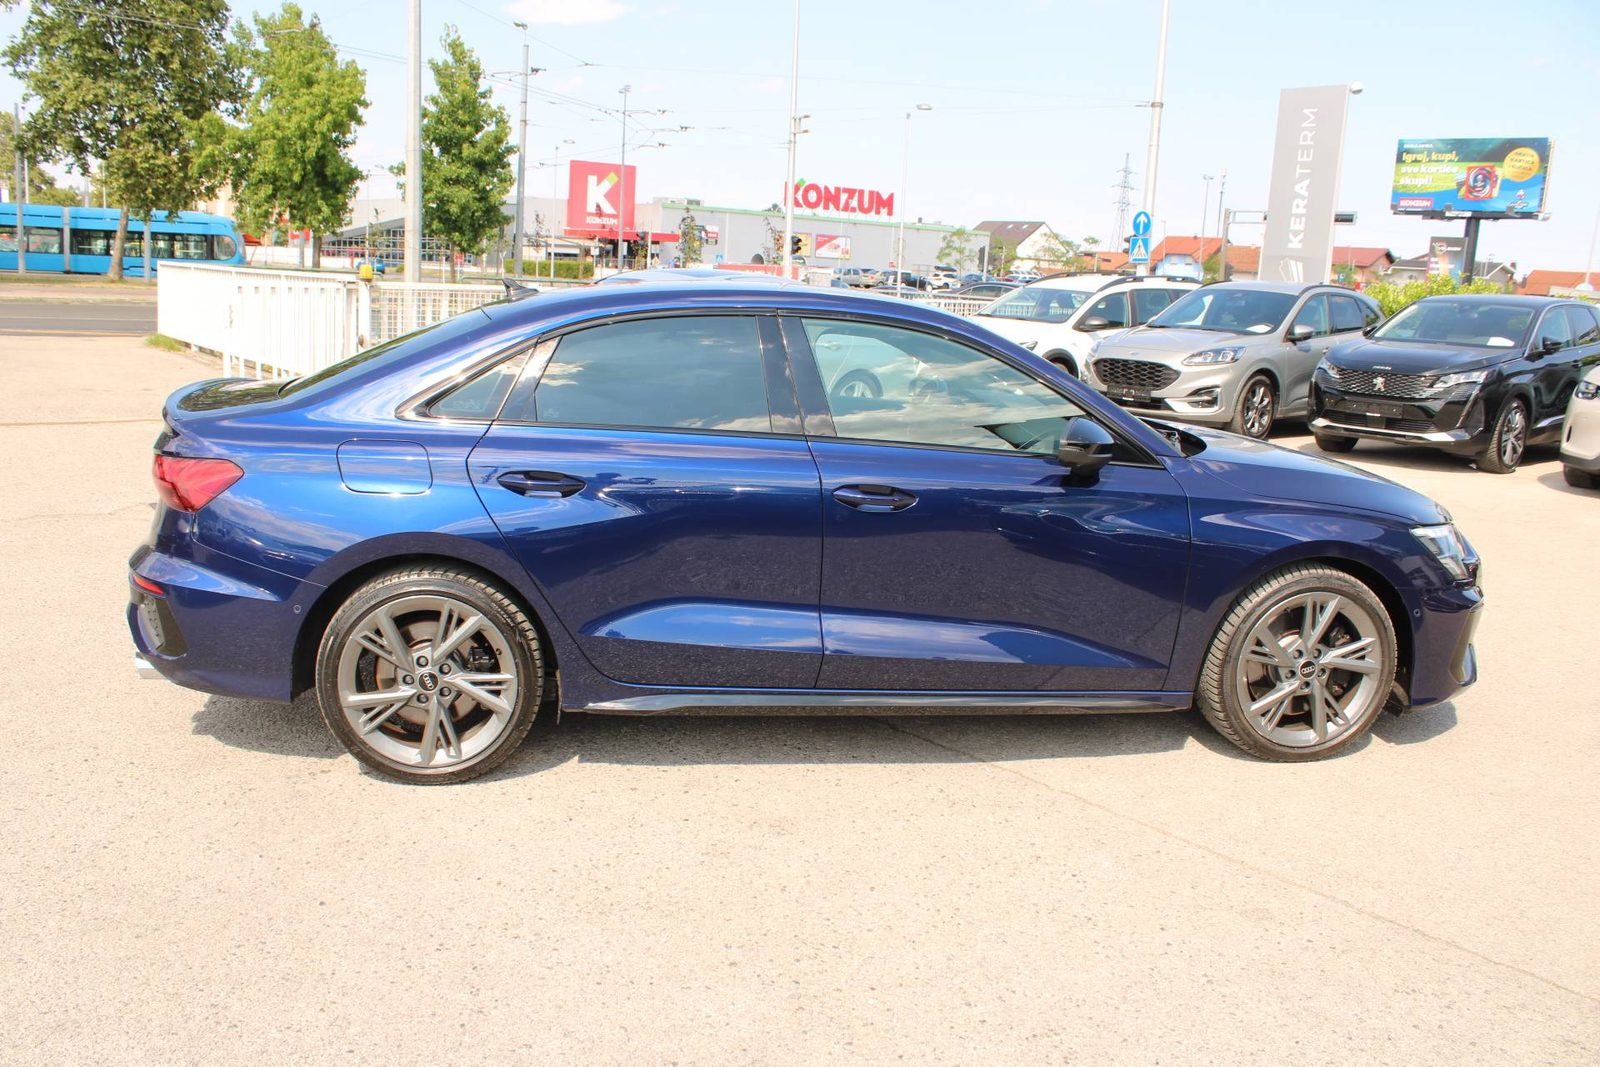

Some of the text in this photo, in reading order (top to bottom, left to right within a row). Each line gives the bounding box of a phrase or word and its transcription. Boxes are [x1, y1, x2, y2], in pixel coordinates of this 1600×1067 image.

[586, 171, 620, 215] K
[784, 179, 895, 217] KONZUM
[1287, 108, 1319, 249] KERATERM
